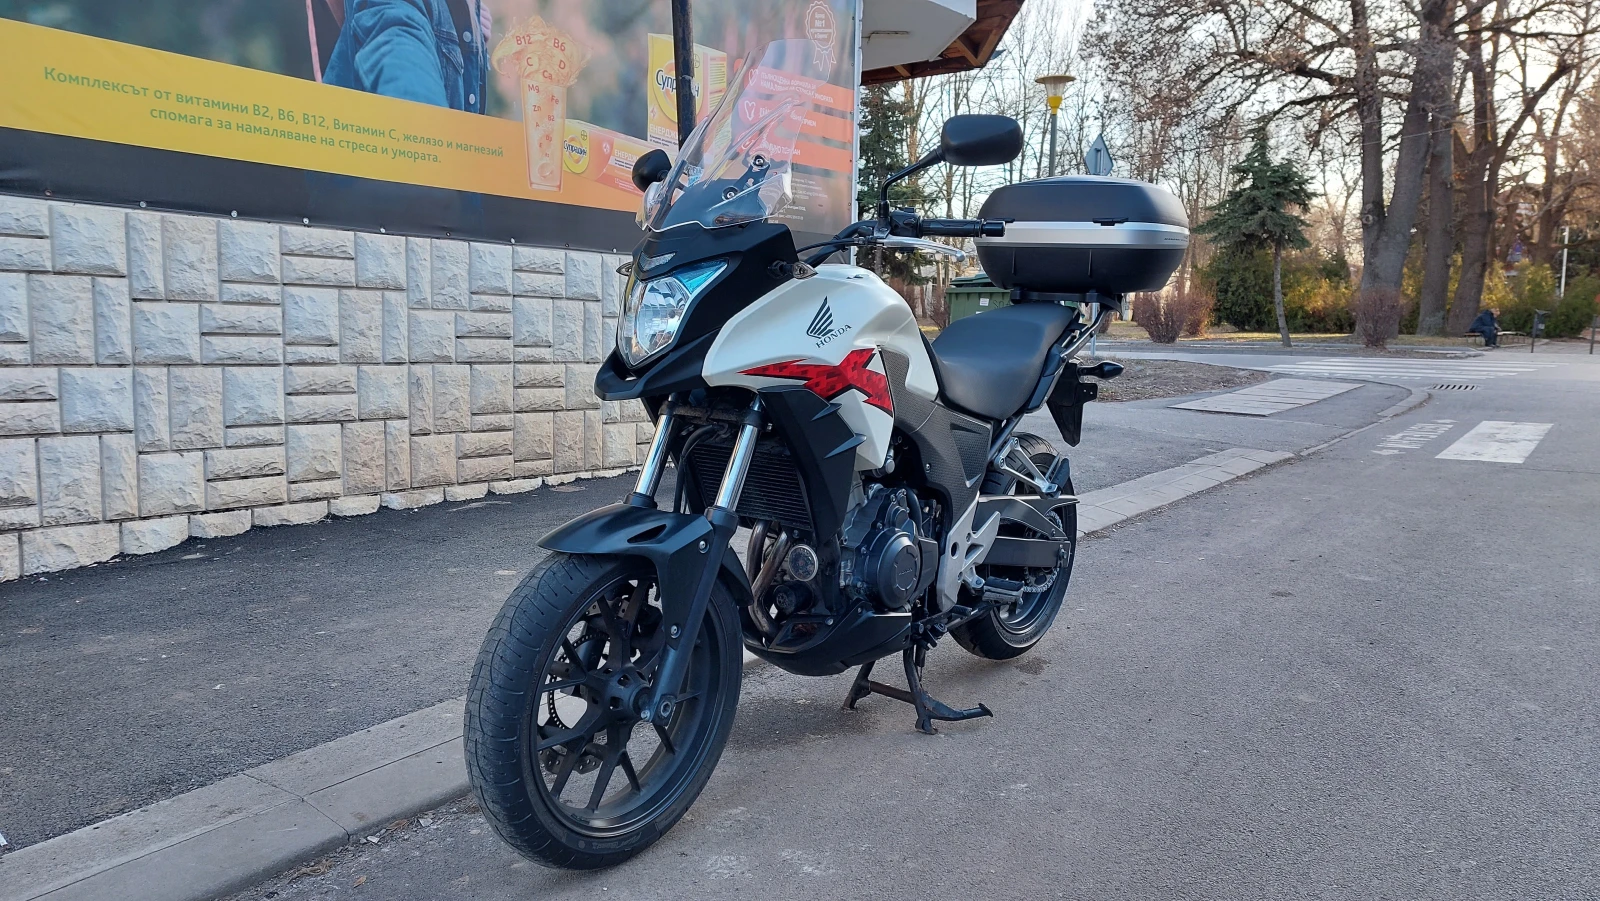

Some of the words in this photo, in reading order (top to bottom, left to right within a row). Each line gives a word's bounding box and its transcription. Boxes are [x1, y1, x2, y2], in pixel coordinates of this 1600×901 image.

[515, 34, 533, 45] B12
[553, 37, 566, 52] B6
[526, 57, 534, 67] C
[558, 59, 566, 70] D
[542, 69, 553, 80] Ca
[528, 83, 540, 94] Mg
[550, 94, 559, 104] Fe
[44, 66, 149, 97] Комплексът
[153, 88, 172, 101] от
[175, 93, 249, 115] витамини
[333, 118, 385, 139] Витамин
[402, 132, 444, 148] желязо
[446, 140, 453, 149] и
[455, 141, 504, 157] магнезий
[532, 104, 542, 112] Zn
[150, 107, 213, 127] спомага
[217, 118, 232, 130] за
[235, 122, 317, 144] намаляване
[320, 136, 336, 148] на
[338, 140, 379, 155] стреса
[381, 146, 389, 155] и
[391, 148, 442, 163] умората.
[815, 324, 852, 348] HONDA
